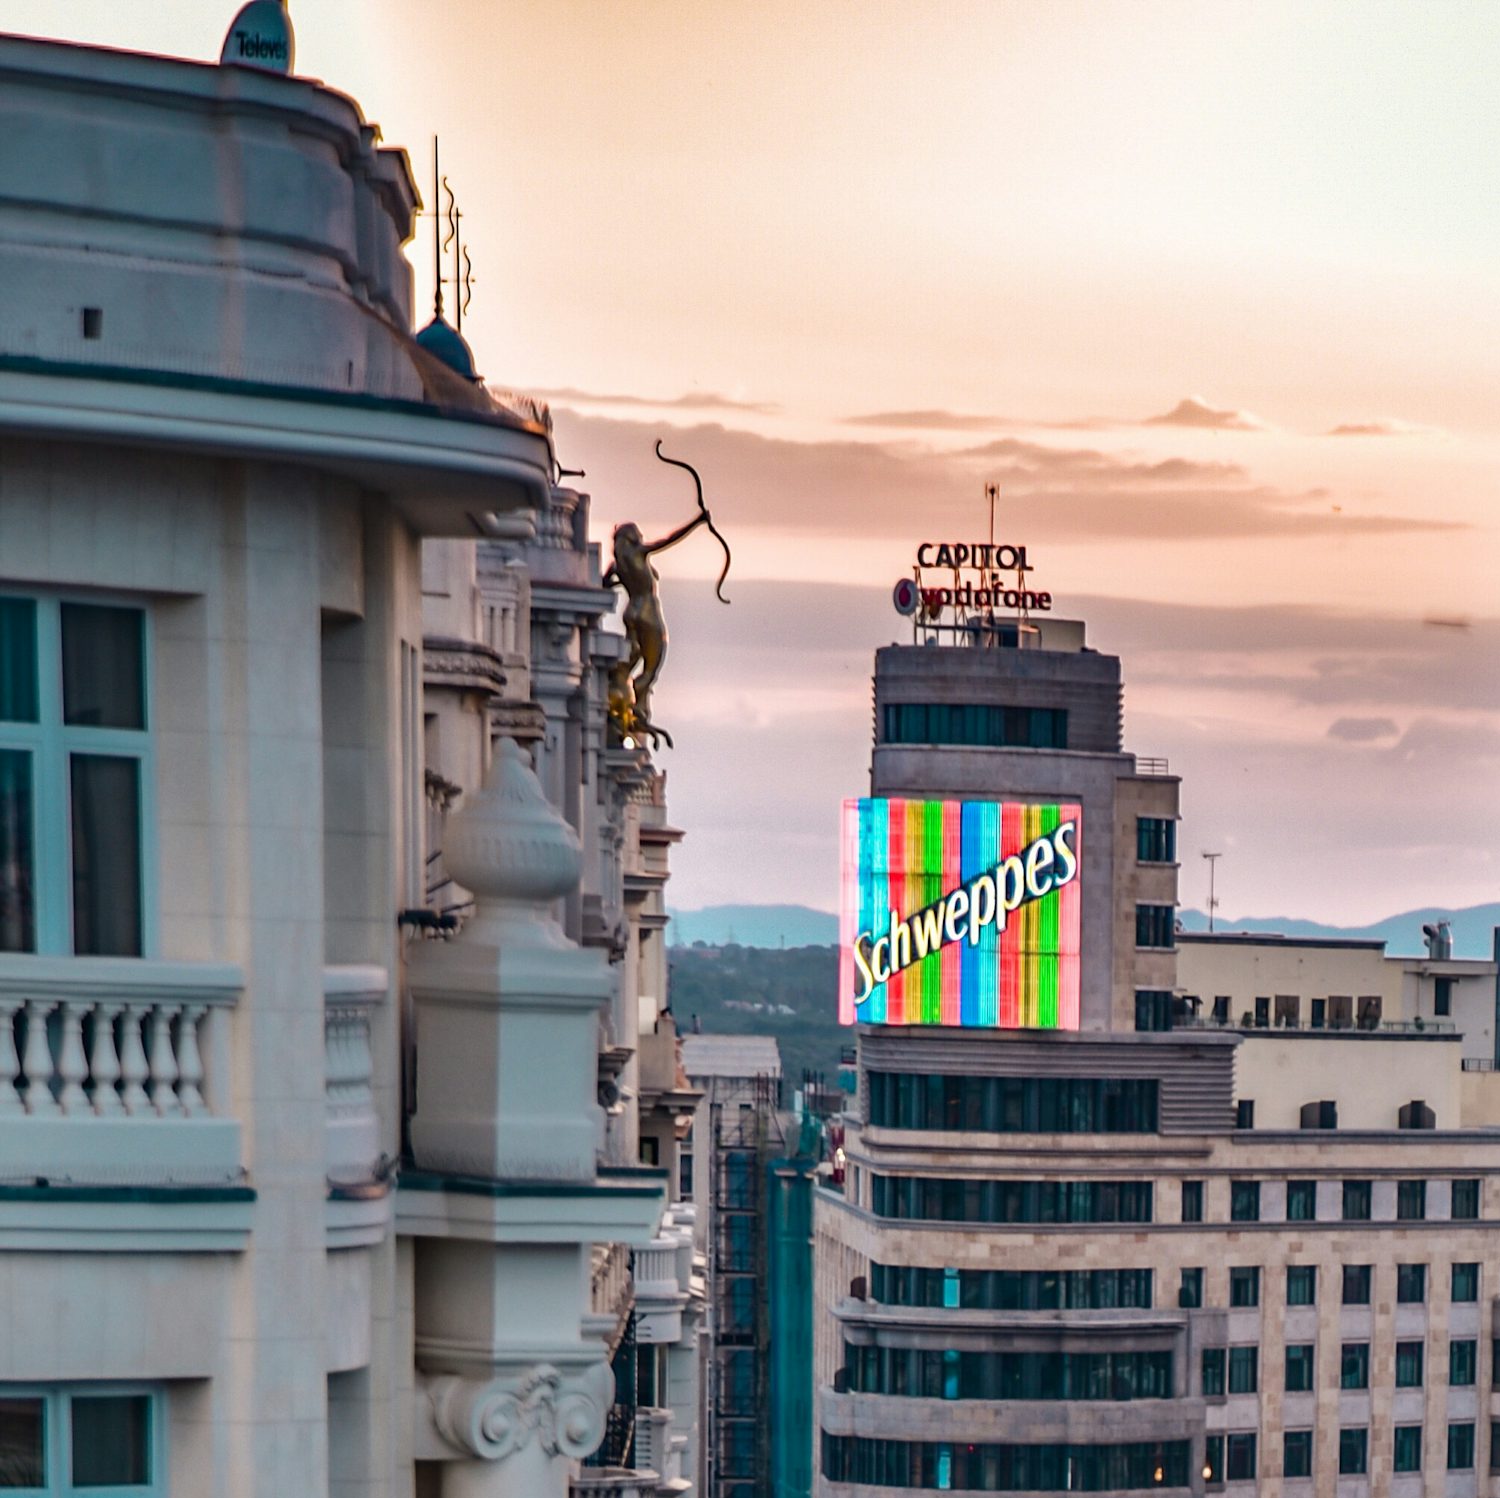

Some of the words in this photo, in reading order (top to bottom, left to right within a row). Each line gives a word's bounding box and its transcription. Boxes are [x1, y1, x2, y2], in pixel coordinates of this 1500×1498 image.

[917, 543, 1034, 571] CAPITOL
[920, 580, 1052, 611] vodafone
[853, 819, 1078, 1006] Schweppes
